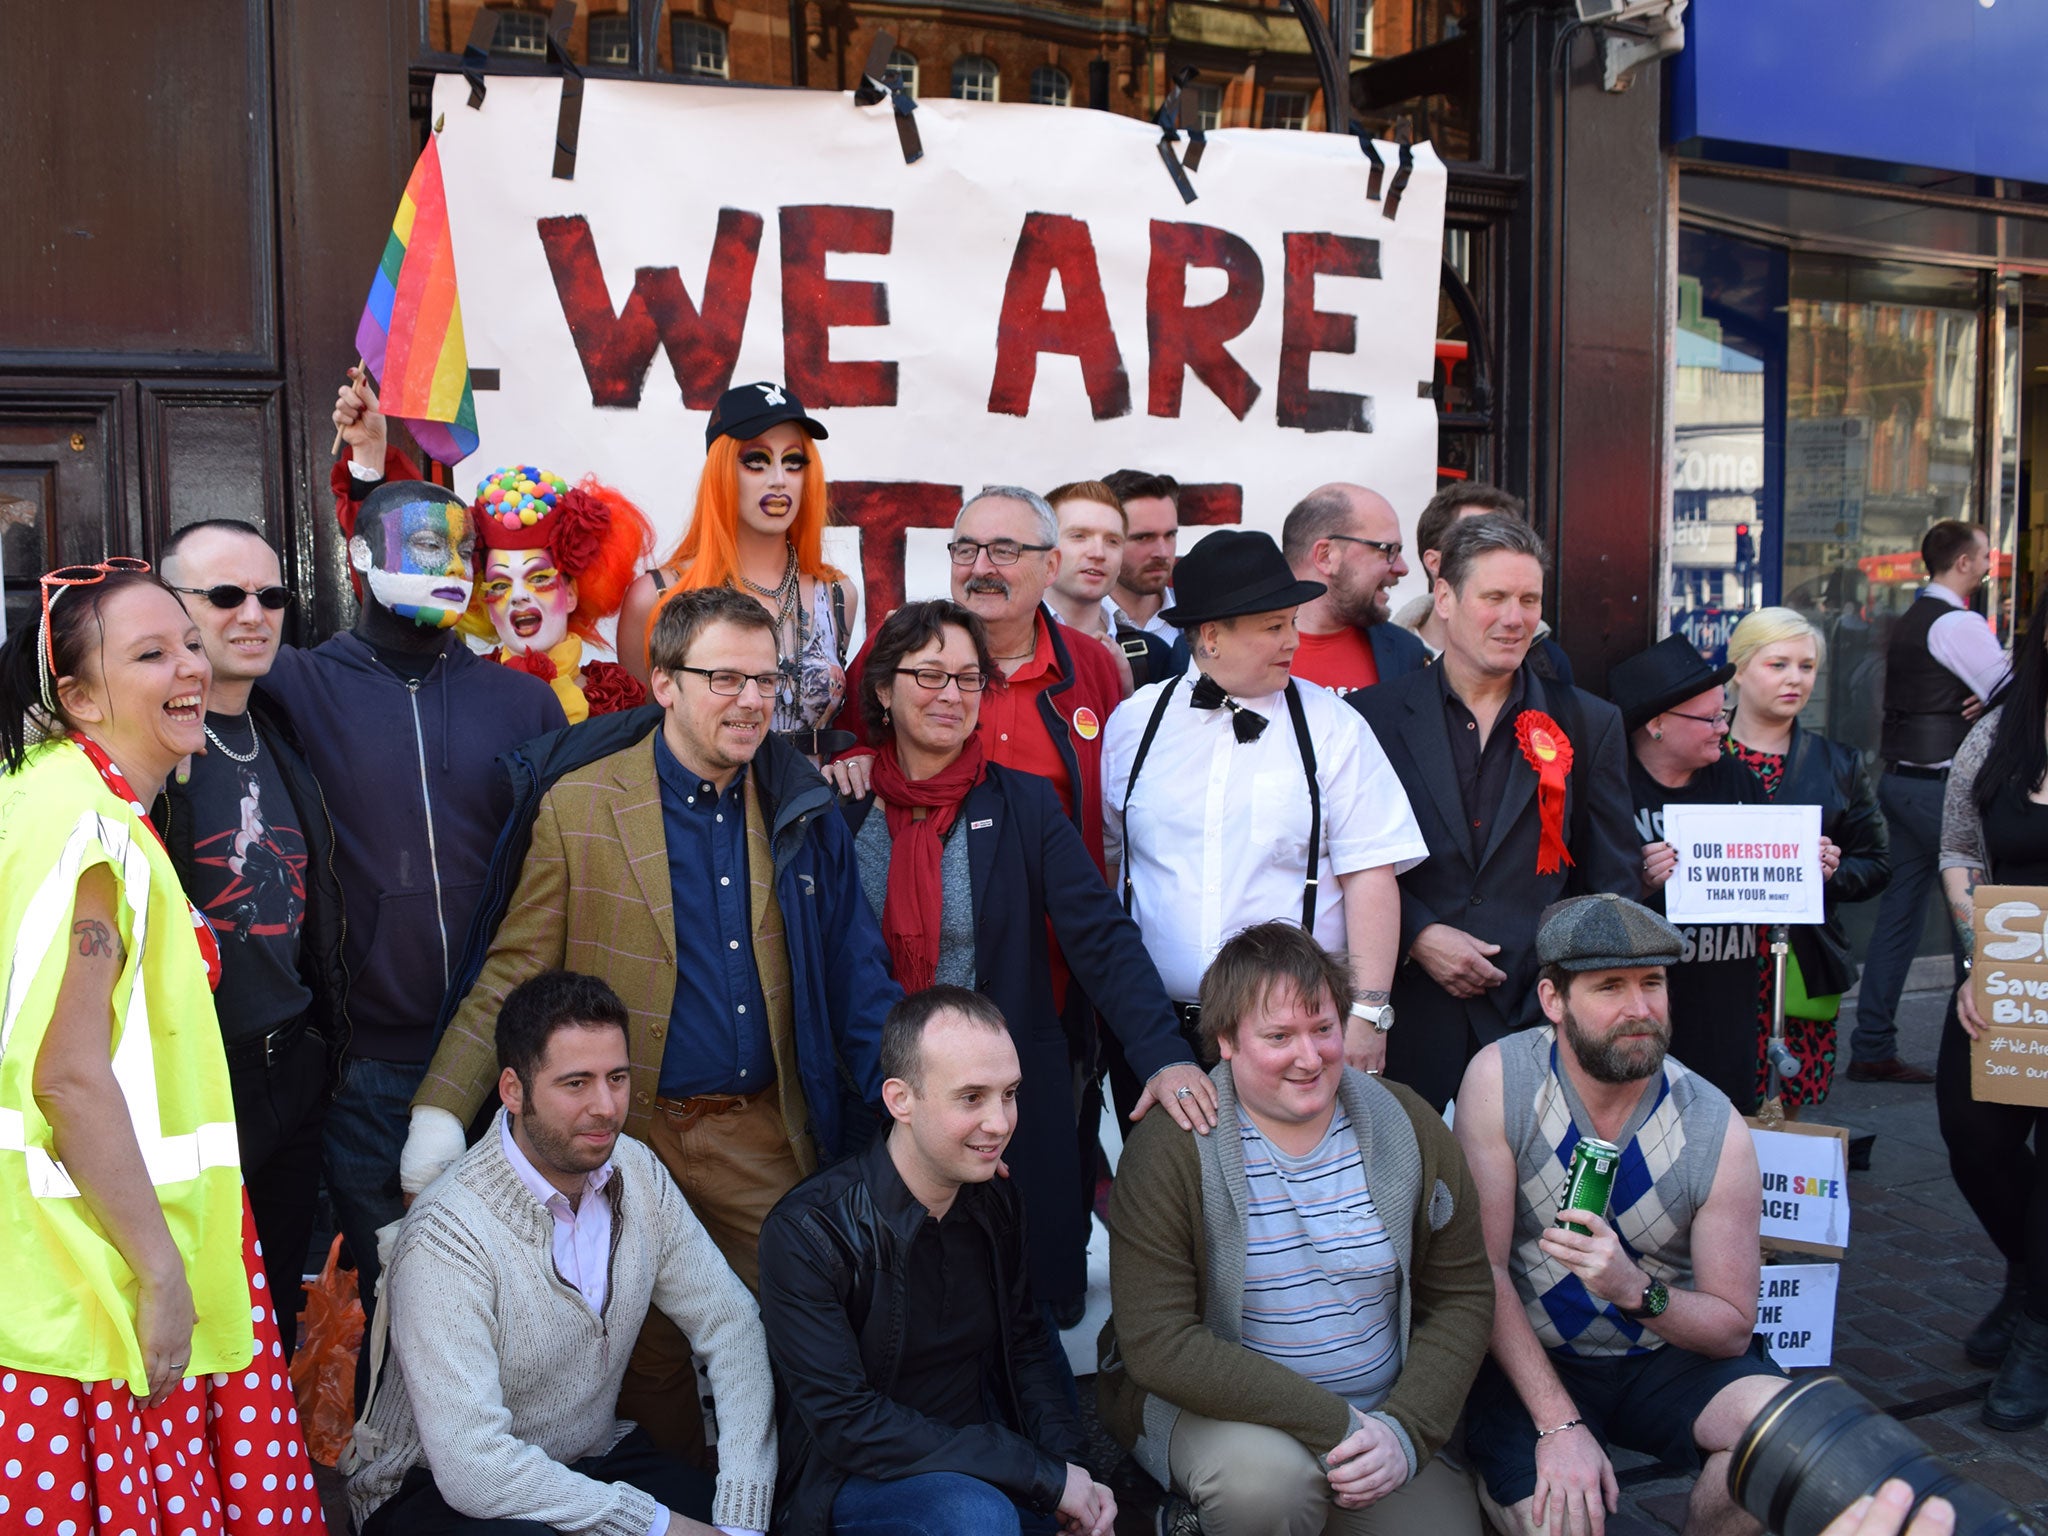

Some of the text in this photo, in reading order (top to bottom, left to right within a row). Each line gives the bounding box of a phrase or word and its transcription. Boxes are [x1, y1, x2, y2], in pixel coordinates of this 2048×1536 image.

[537, 204, 1382, 433] WE ARE
[1693, 843, 1799, 859] OUR HERSTORY
[1688, 866, 1803, 882] IS WORTH MORE
[1706, 888, 1735, 900] THAN
[1738, 888, 1766, 900] YOUR
[1985, 971, 2048, 1000] Save
[1985, 1059, 2019, 1076] Save
[1793, 1175, 1839, 1199] SAFE
[1768, 1279, 1800, 1297] ARE
[1778, 1331, 1811, 1349] CAP
